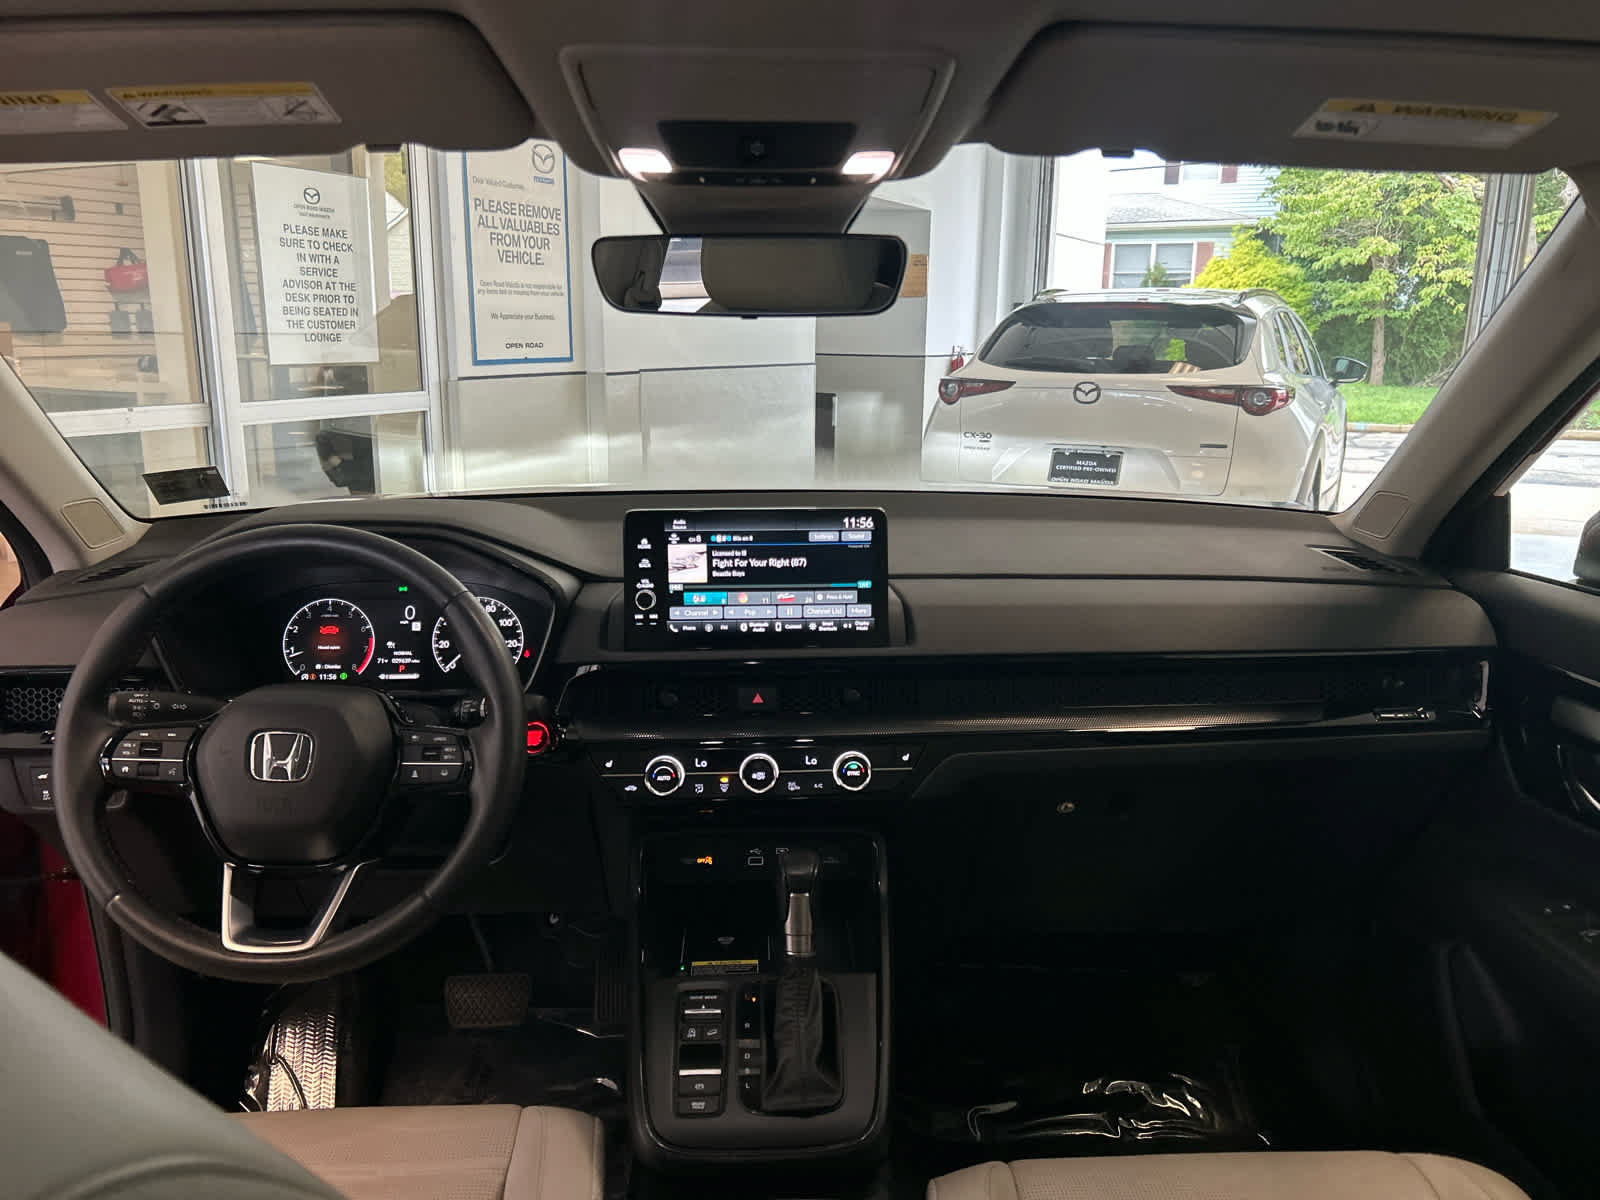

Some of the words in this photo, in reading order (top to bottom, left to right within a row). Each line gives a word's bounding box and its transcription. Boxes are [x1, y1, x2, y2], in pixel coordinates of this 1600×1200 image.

[474, 198, 517, 216] PLEASE
[519, 203, 561, 222] REMOVE
[478, 214, 499, 230] ALL
[500, 217, 560, 236] VALUABLES
[283, 224, 320, 236] PLEASE
[322, 228, 349, 239] MAKE
[280, 237, 305, 249] SURE
[308, 240, 320, 250] TO
[323, 241, 353, 253] CHECK
[490, 231, 520, 248] FROM
[522, 235, 550, 250] YOUR
[297, 253, 306, 263] IN
[309, 254, 331, 264] WITH
[334, 256, 340, 265] A
[498, 249, 545, 266] VEHICLE.
[300, 267, 339, 278] SERVICE
[283, 279, 323, 290] ADVISOR
[325, 282, 337, 291] AT
[339, 282, 357, 292] THE
[285, 292, 311, 303] DESK
[313, 294, 340, 304] PRIOR
[343, 295, 355, 304] TO
[283, 306, 311, 316] BEING
[313, 307, 348, 317] SEATED
[351, 308, 359, 317] IN
[286, 320, 305, 329] THE
[307, 320, 356, 330] CUSTOMER
[304, 333, 342, 343] LOUNGE
[963, 431, 992, 439] CX-30
[843, 517, 874, 529] 11:56
[697, 534, 702, 543] 8
[712, 559, 733, 569] Fight
[734, 559, 748, 568] For
[749, 558, 768, 568] Your
[769, 558, 790, 569] Right
[791, 557, 807, 568] (87)
[712, 570, 732, 578] Beastie
[732, 570, 746, 578] Boys
[405, 605, 416, 621] 0
[486, 605, 497, 613] 80
[684, 609, 709, 617] Channel
[499, 619, 513, 627] 100
[293, 626, 299, 634] 2
[439, 640, 450, 649] 20
[399, 665, 406, 673] P
[695, 758, 708, 768] Lo
[805, 755, 818, 765] Lo
